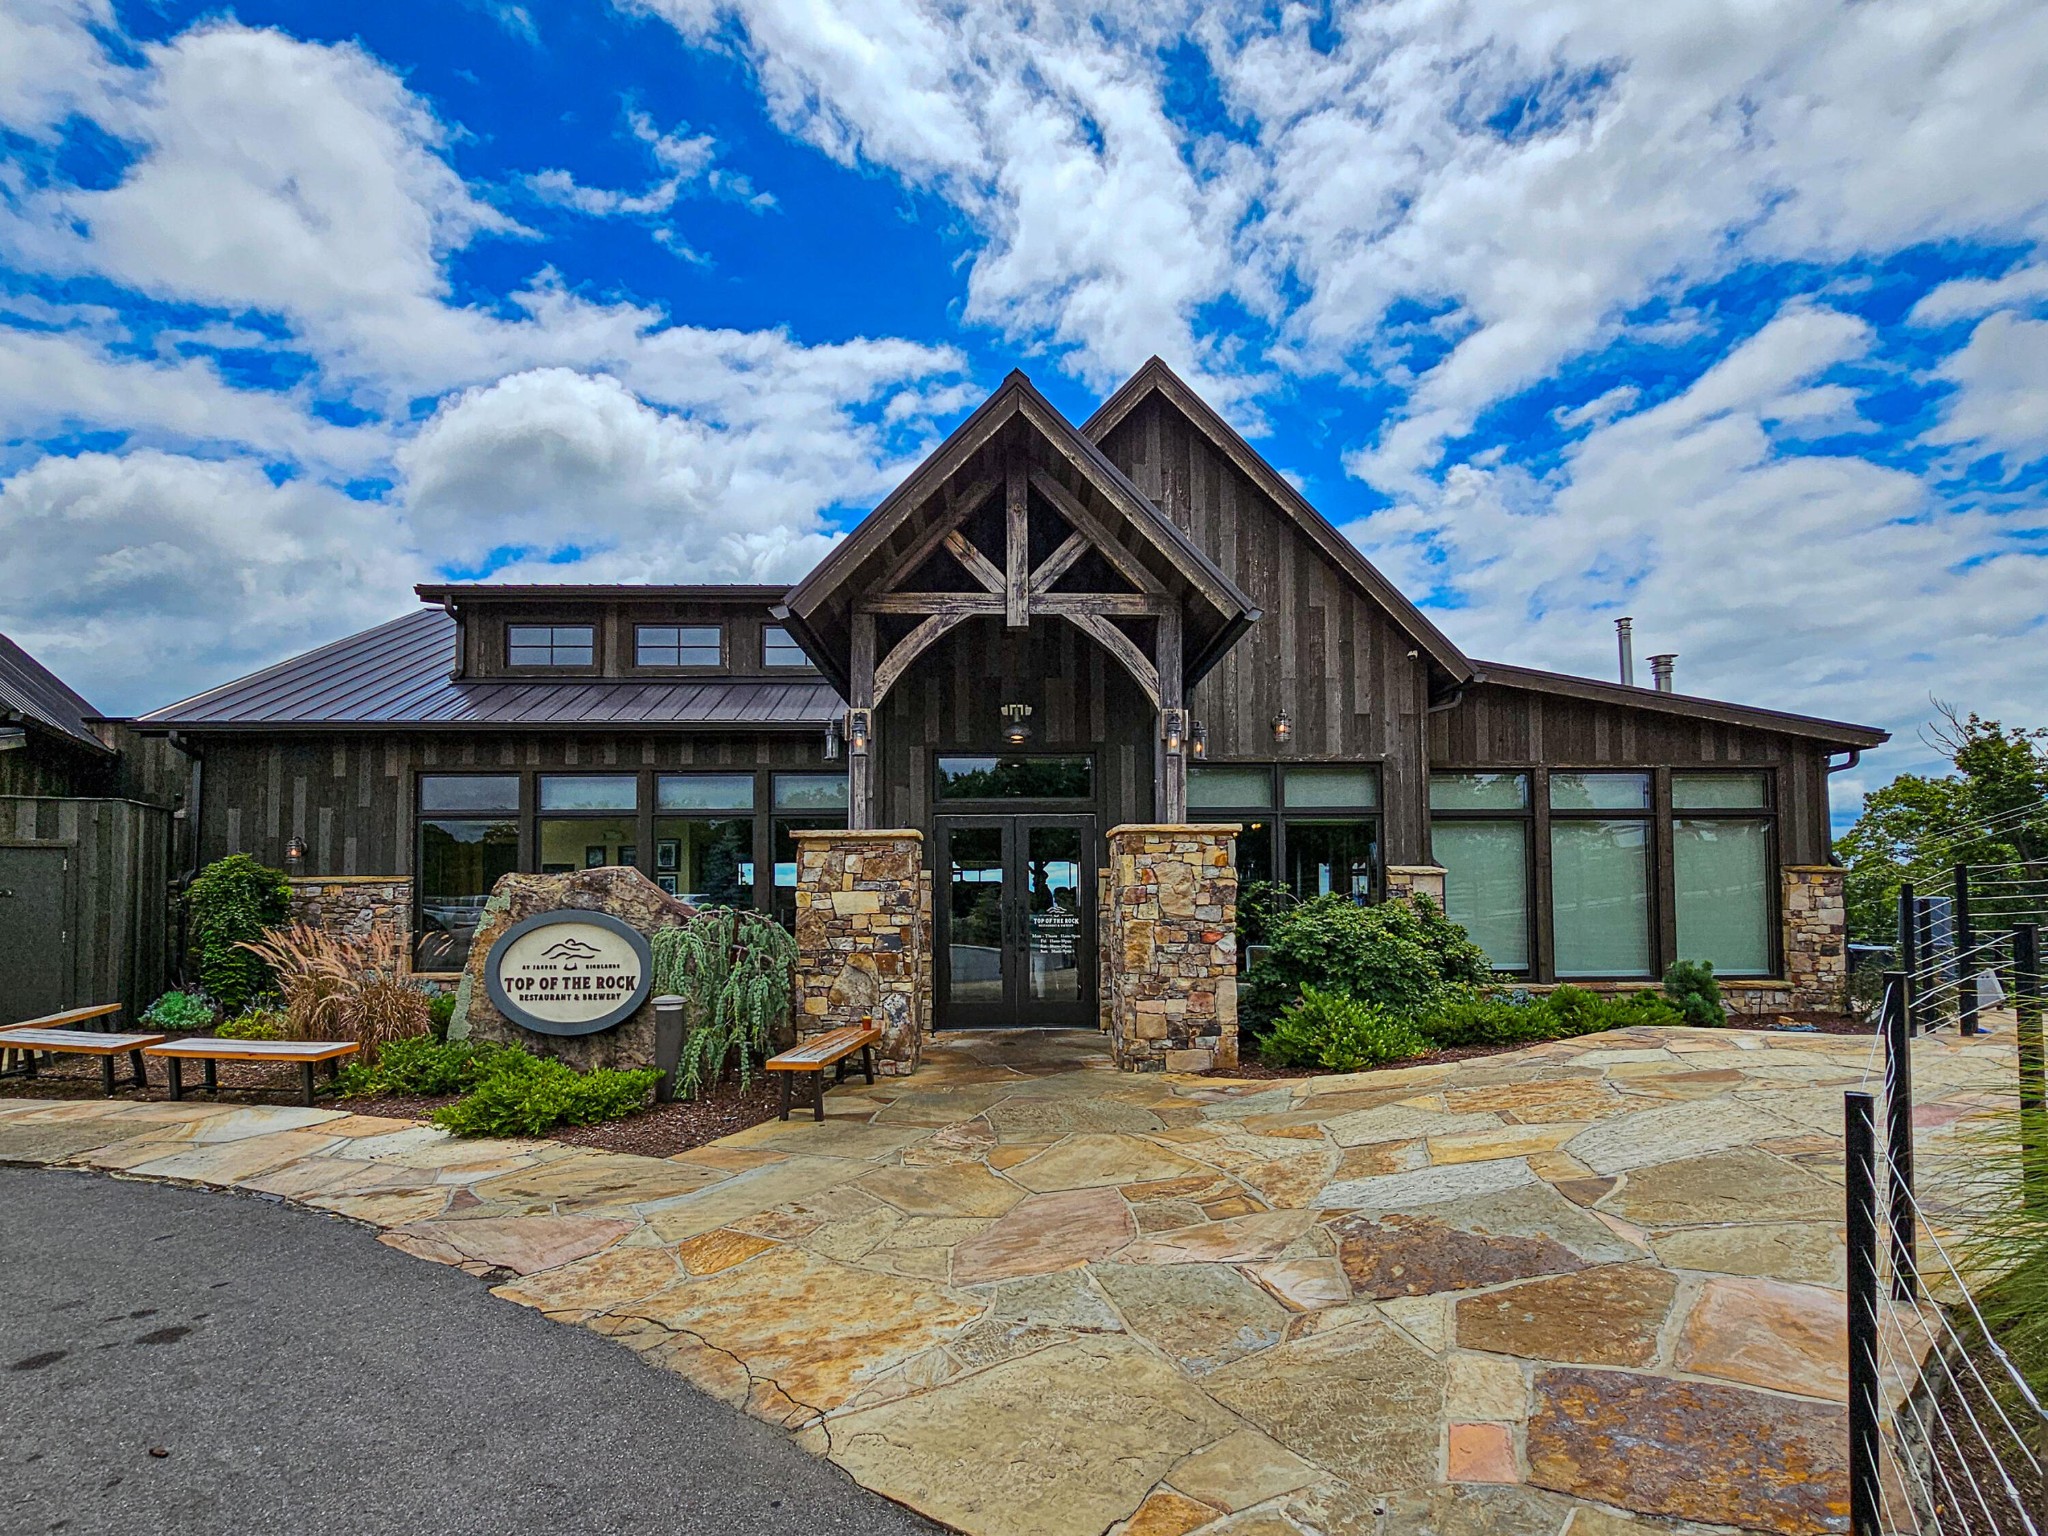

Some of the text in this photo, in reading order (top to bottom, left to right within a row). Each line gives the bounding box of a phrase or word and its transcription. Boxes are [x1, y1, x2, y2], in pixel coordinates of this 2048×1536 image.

[504, 976, 636, 993] TOP OF THE ROCK
[582, 993, 621, 1001] BREWERY
